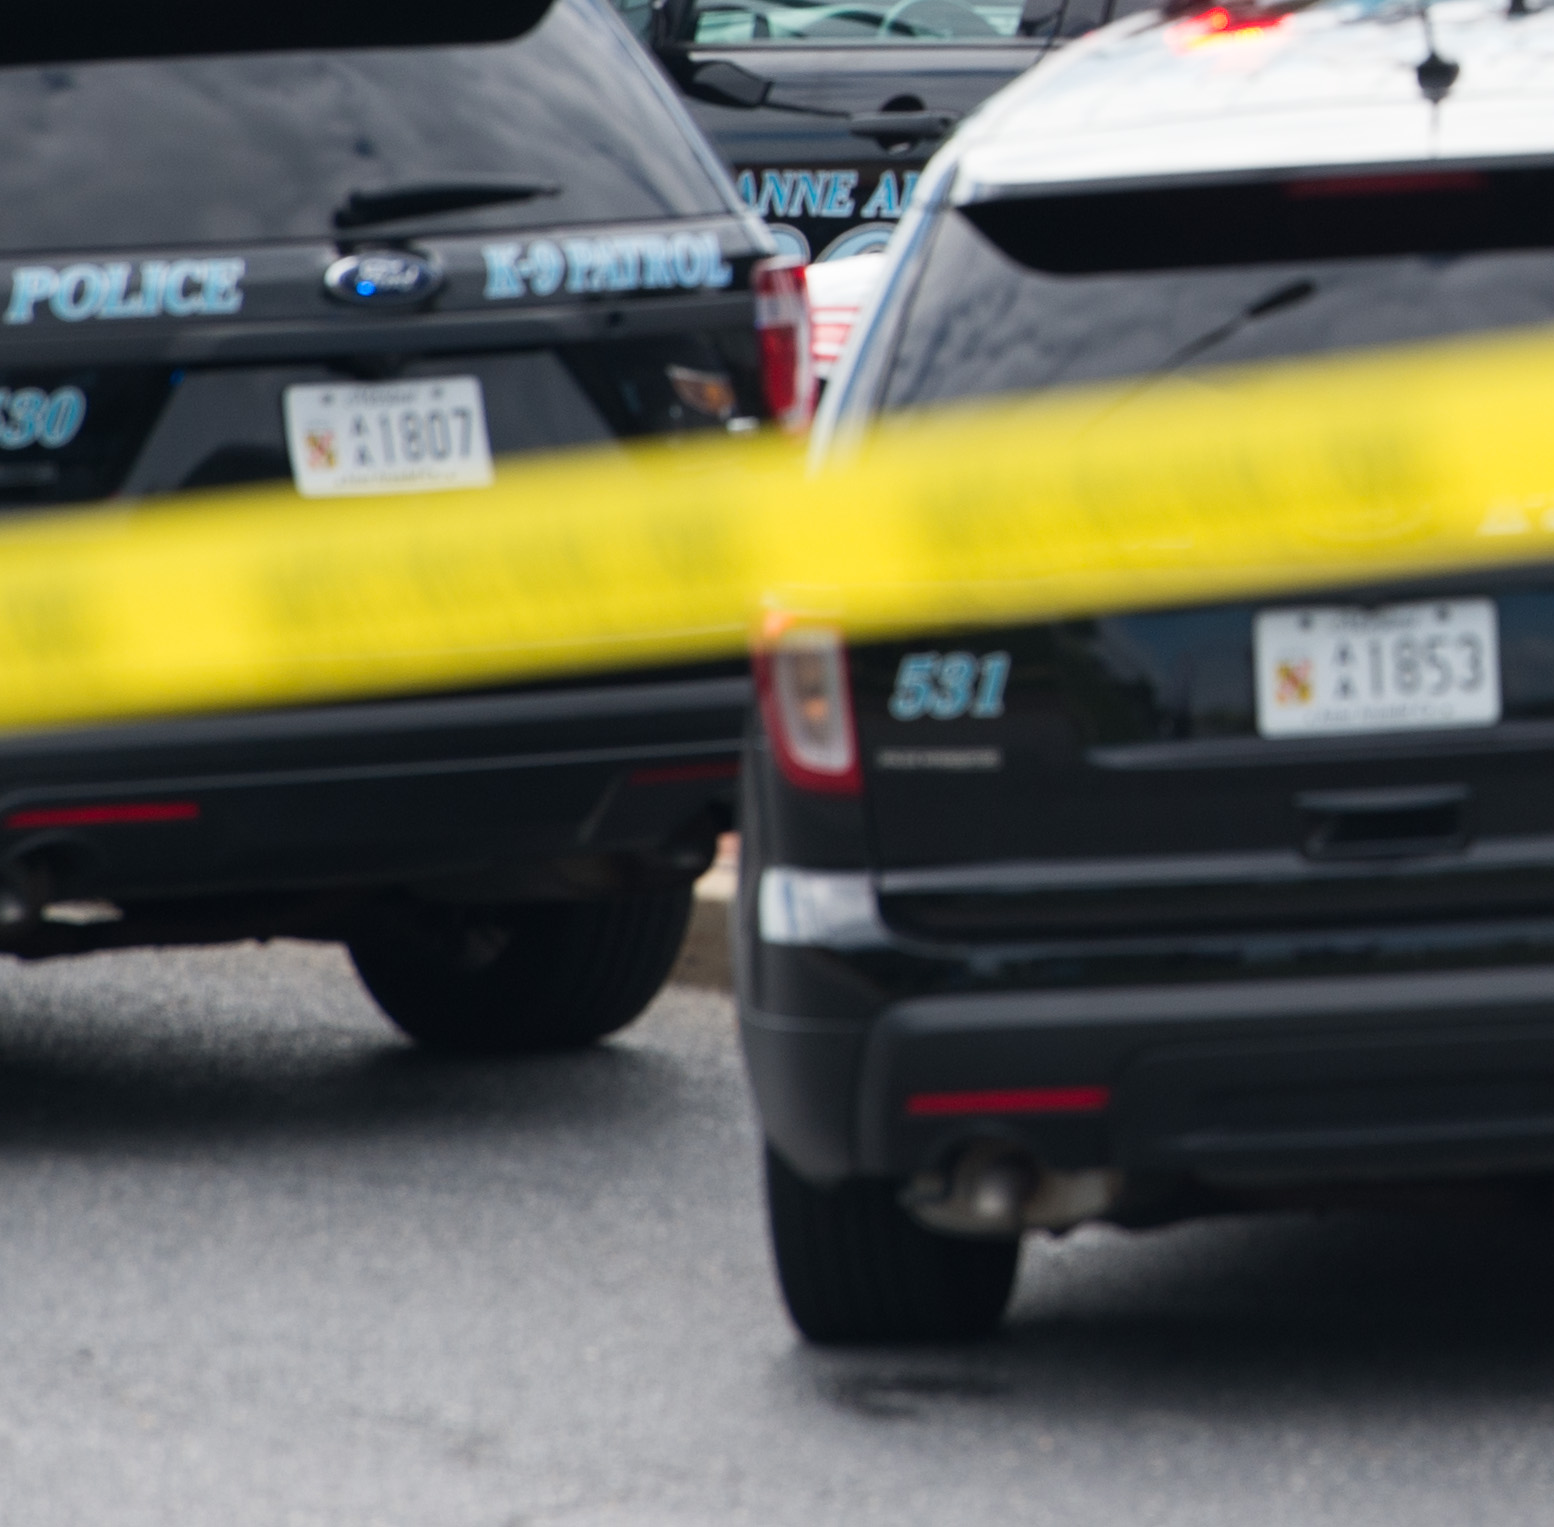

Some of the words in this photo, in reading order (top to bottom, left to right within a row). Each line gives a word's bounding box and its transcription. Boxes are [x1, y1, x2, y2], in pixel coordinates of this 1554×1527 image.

[737, 169, 859, 218] ANNE
[3, 257, 246, 324] POLICE
[481, 240, 565, 300] K-9
[563, 232, 733, 293] PATROL
[379, 406, 472, 466] 1807
[888, 651, 1011, 720] 531
[1368, 632, 1484, 699] 1853
